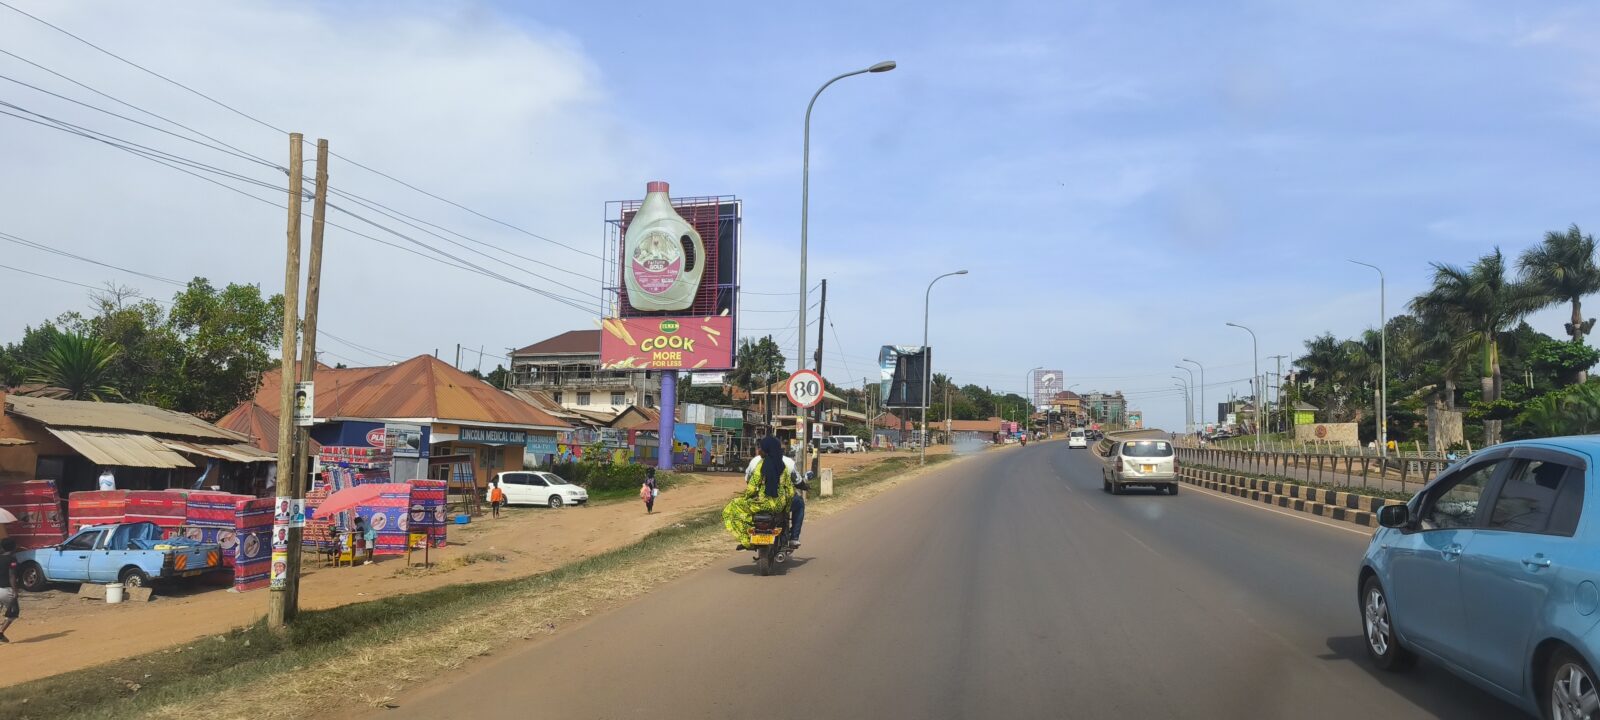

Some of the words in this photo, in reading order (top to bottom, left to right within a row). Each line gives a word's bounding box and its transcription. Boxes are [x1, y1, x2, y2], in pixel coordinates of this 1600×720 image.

[641, 335, 695, 352] COOK
[653, 351, 682, 360] MORE
[794, 381, 819, 397] 80
[462, 428, 485, 441] LINCOLN
[486, 430, 508, 442] MEDICAL
[510, 431, 525, 443] CLINIC
